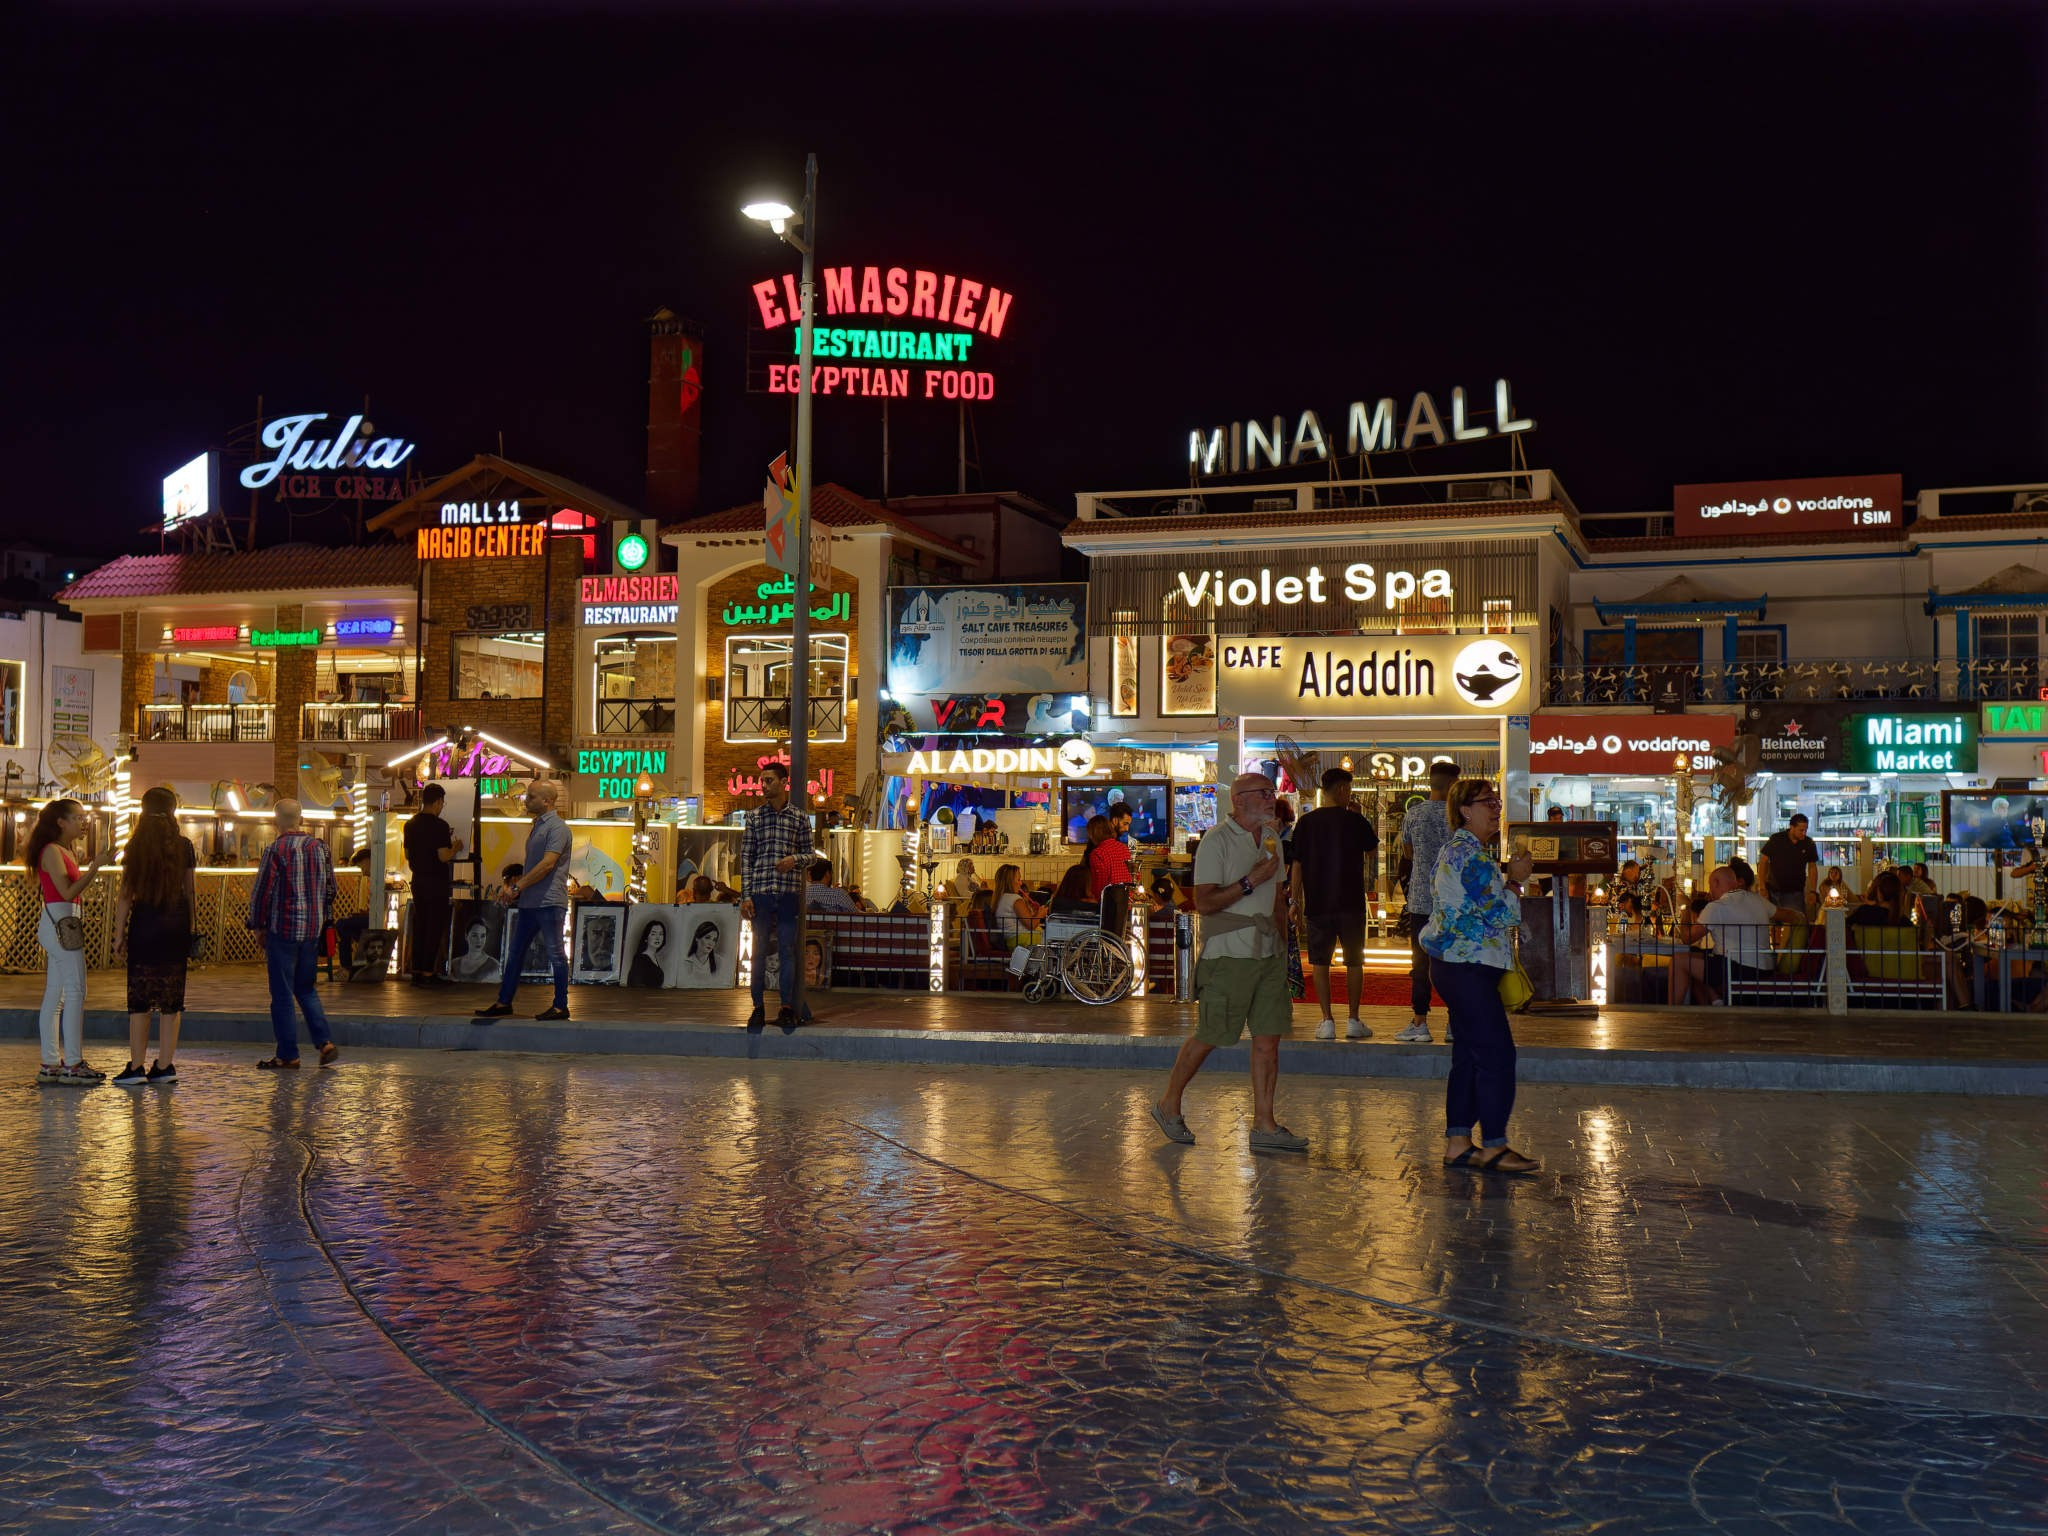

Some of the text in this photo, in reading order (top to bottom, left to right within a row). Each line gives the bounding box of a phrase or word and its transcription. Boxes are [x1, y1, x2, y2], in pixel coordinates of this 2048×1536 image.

[753, 266, 1013, 338] EL MASRIEN
[925, 371, 995, 400] FOOD
[1190, 378, 1537, 475] MINA MALL
[239, 412, 416, 489] Julia
[279, 475, 321, 498] ICE
[441, 500, 521, 525] MALL 11
[1796, 495, 1873, 511] vodafone
[1862, 511, 1892, 525] SIM
[417, 524, 544, 559] NAGIB CENTER
[1178, 564, 1452, 610] Violet Spa
[584, 605, 679, 624] RESTAURANT
[962, 621, 1069, 633] SALT CAVE TREASURES
[987, 648, 1008, 656] DELLA
[1009, 647, 1039, 656] GROTTA
[1049, 647, 1068, 655] SALE
[1224, 644, 1282, 670] CAFE
[1298, 649, 1435, 699] Aladdin
[1867, 717, 1962, 745] Miami
[1627, 736, 1711, 752] vodafone
[1761, 738, 1825, 750] Heineken
[1761, 751, 1825, 761] open your world
[578, 751, 666, 774] EGYPTIAN
[906, 748, 1054, 775] ALADDIN
[1876, 750, 1953, 770] Market
